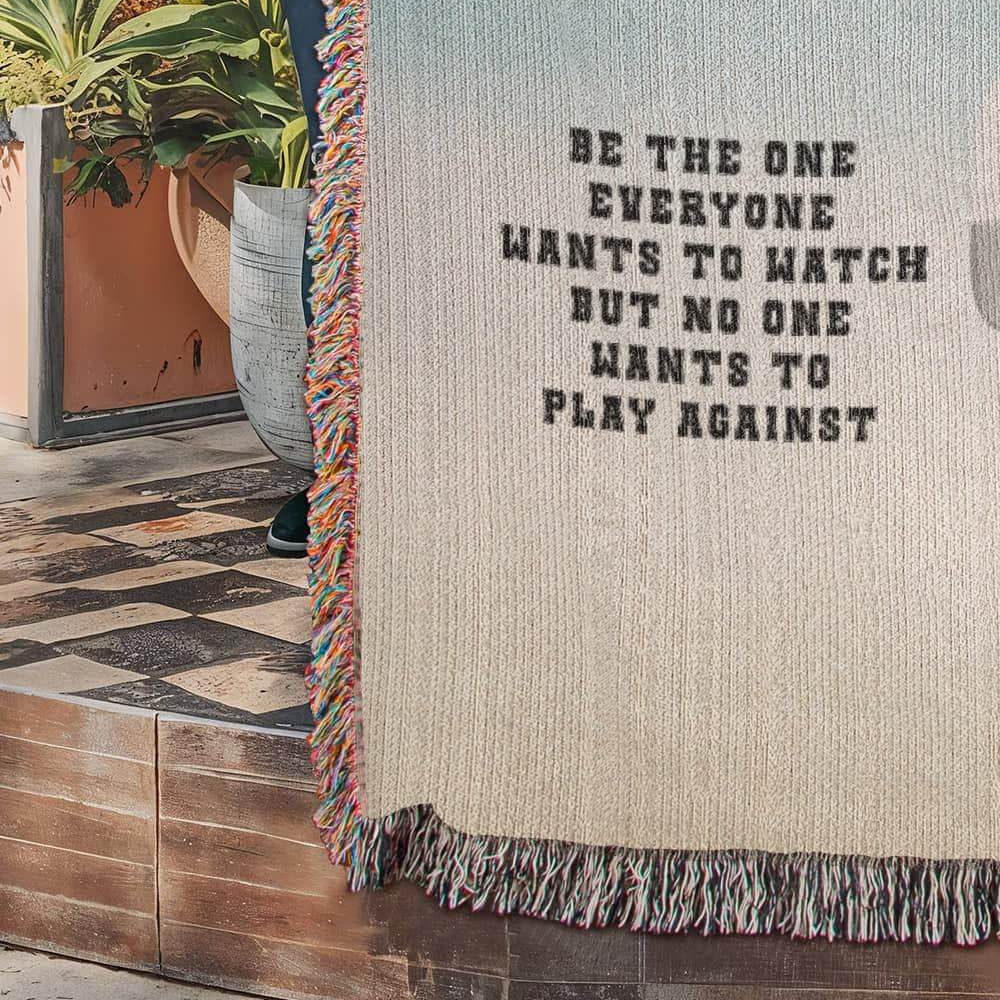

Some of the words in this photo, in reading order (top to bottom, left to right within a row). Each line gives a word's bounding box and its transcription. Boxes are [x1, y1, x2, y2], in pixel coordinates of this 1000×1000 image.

[569, 128, 622, 167] BE
[646, 135, 741, 175] THE
[765, 141, 856, 177] ONE
[589, 182, 835, 231] EVERYONE
[501, 223, 661, 276] WANTS
[684, 243, 742, 281] TO
[766, 246, 927, 284] WATCH
[571, 287, 659, 328] BUT
[683, 296, 740, 334] NO
[763, 299, 851, 336] ONE
[591, 341, 749, 387] WANTS
[772, 352, 830, 390] TO
[543, 388, 655, 434] PLAY
[678, 402, 877, 442] AGAINST
